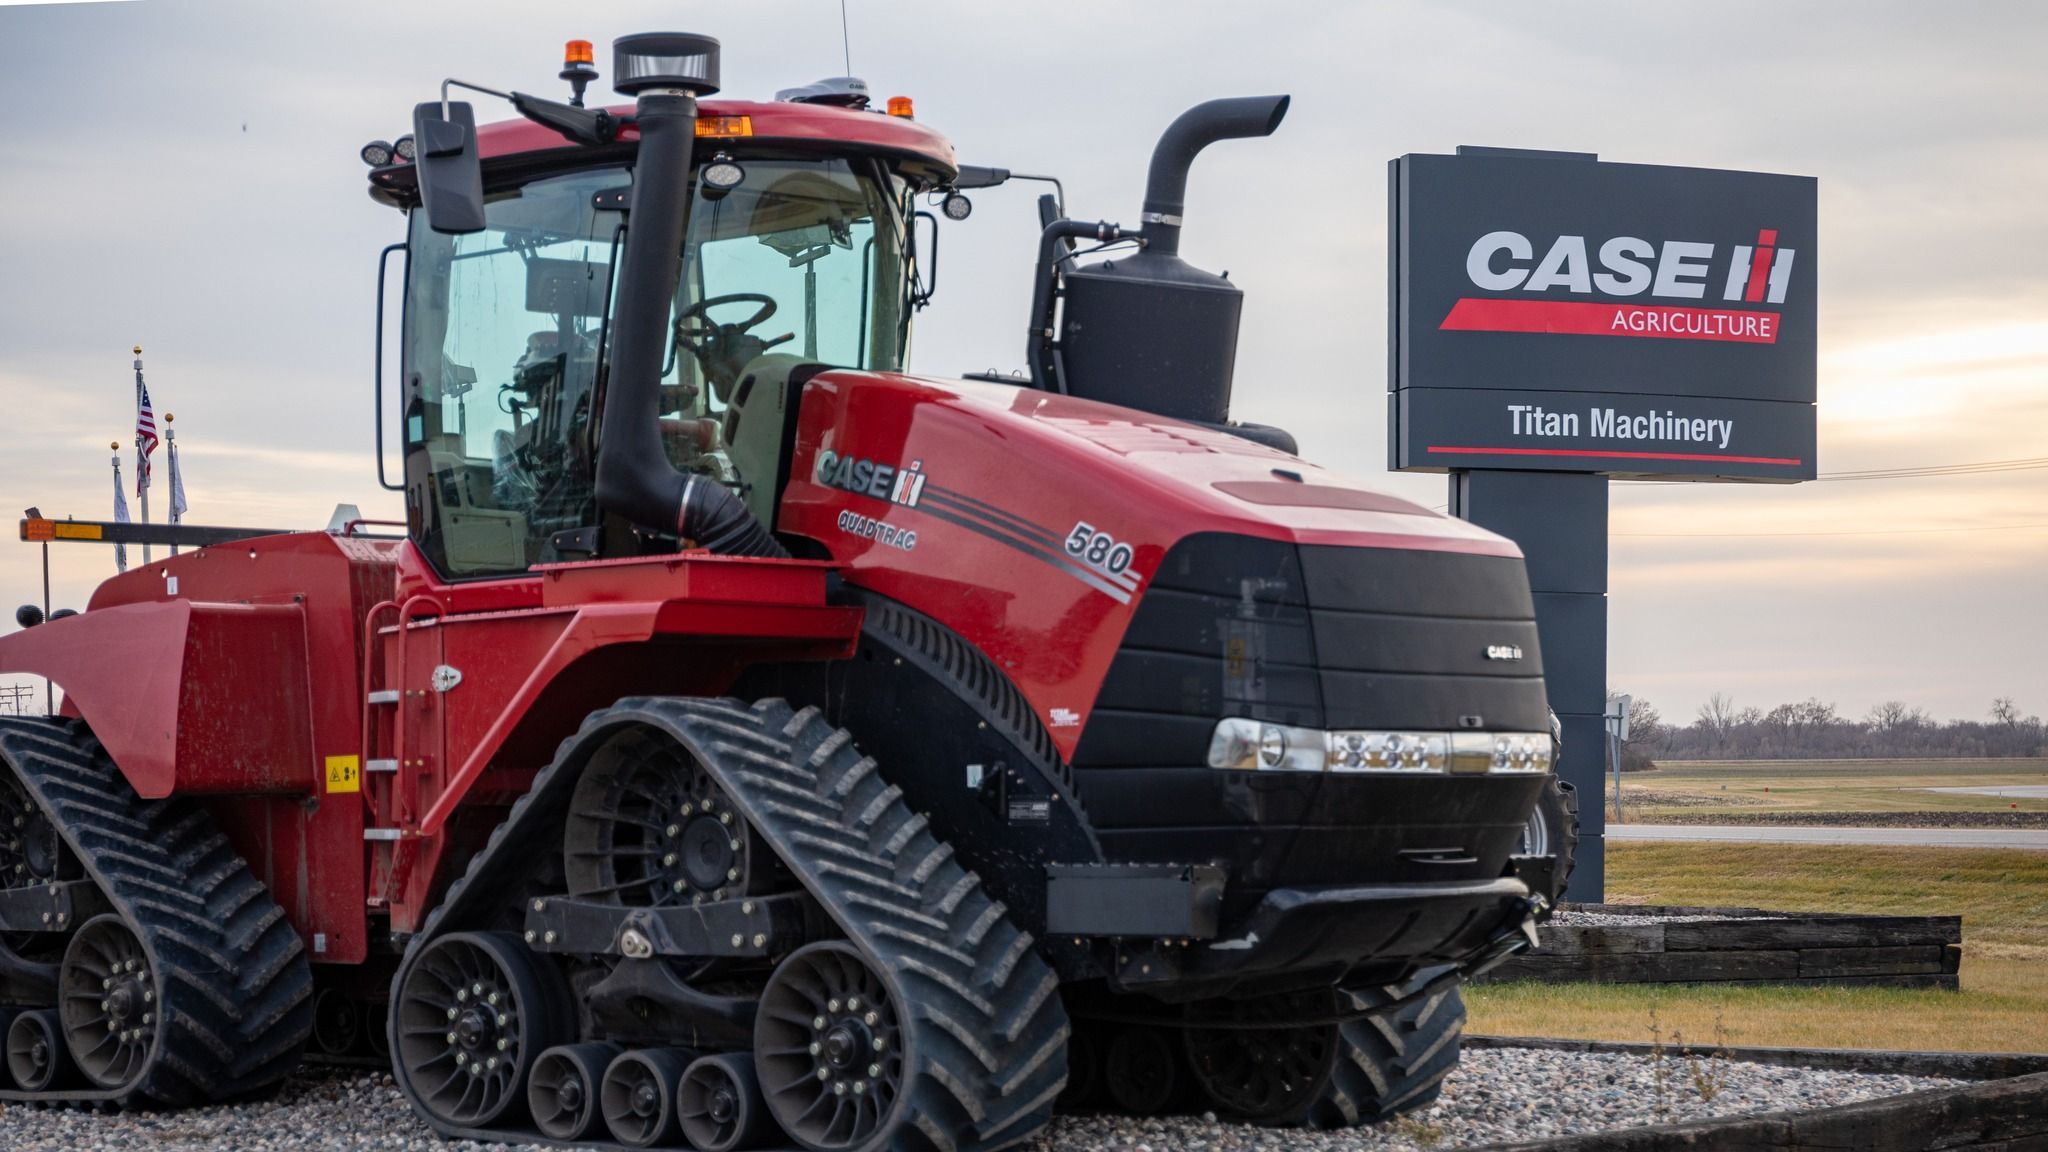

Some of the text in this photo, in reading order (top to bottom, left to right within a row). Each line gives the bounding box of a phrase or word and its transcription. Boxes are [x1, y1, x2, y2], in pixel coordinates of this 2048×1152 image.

[1466, 230, 1715, 299] CASE
[1611, 309, 1771, 338] AGRICULTURE
[1507, 404, 1733, 449] Titan Machinery
[817, 449, 895, 499] CASE
[838, 508, 918, 552] QUADTRAC
[1065, 521, 1134, 576] 580
[1487, 645, 1513, 659] CASE
